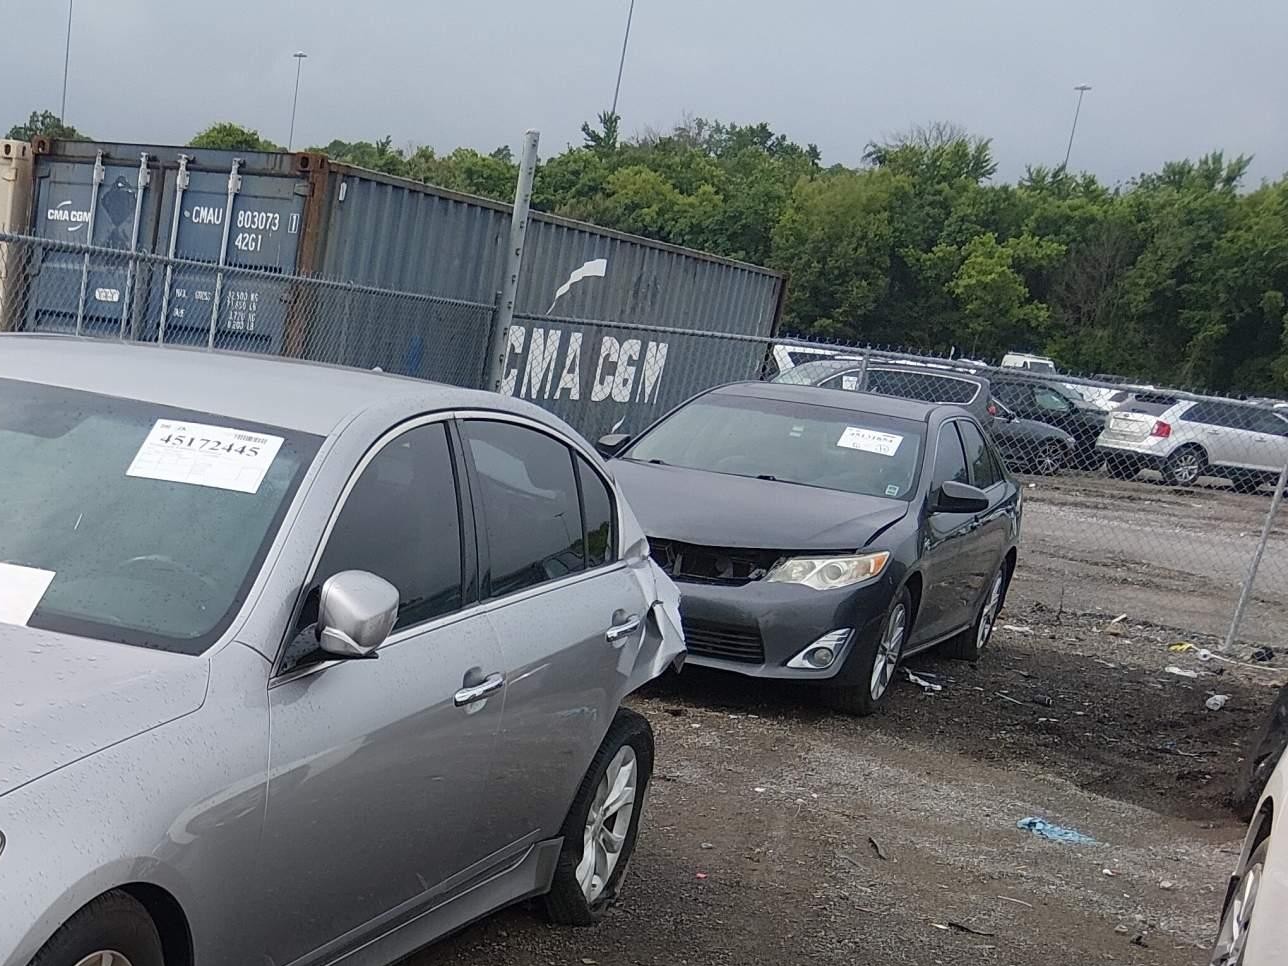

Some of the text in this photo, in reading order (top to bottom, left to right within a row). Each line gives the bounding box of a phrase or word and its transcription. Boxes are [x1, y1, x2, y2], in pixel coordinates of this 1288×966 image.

[48, 209, 69, 221] CMA
[192, 206, 223, 224] CMAU
[237, 210, 279, 231] 803073
[235, 233, 262, 251] 42G1
[500, 326, 668, 404] CMA CGM
[160, 434, 261, 457] 45172445
